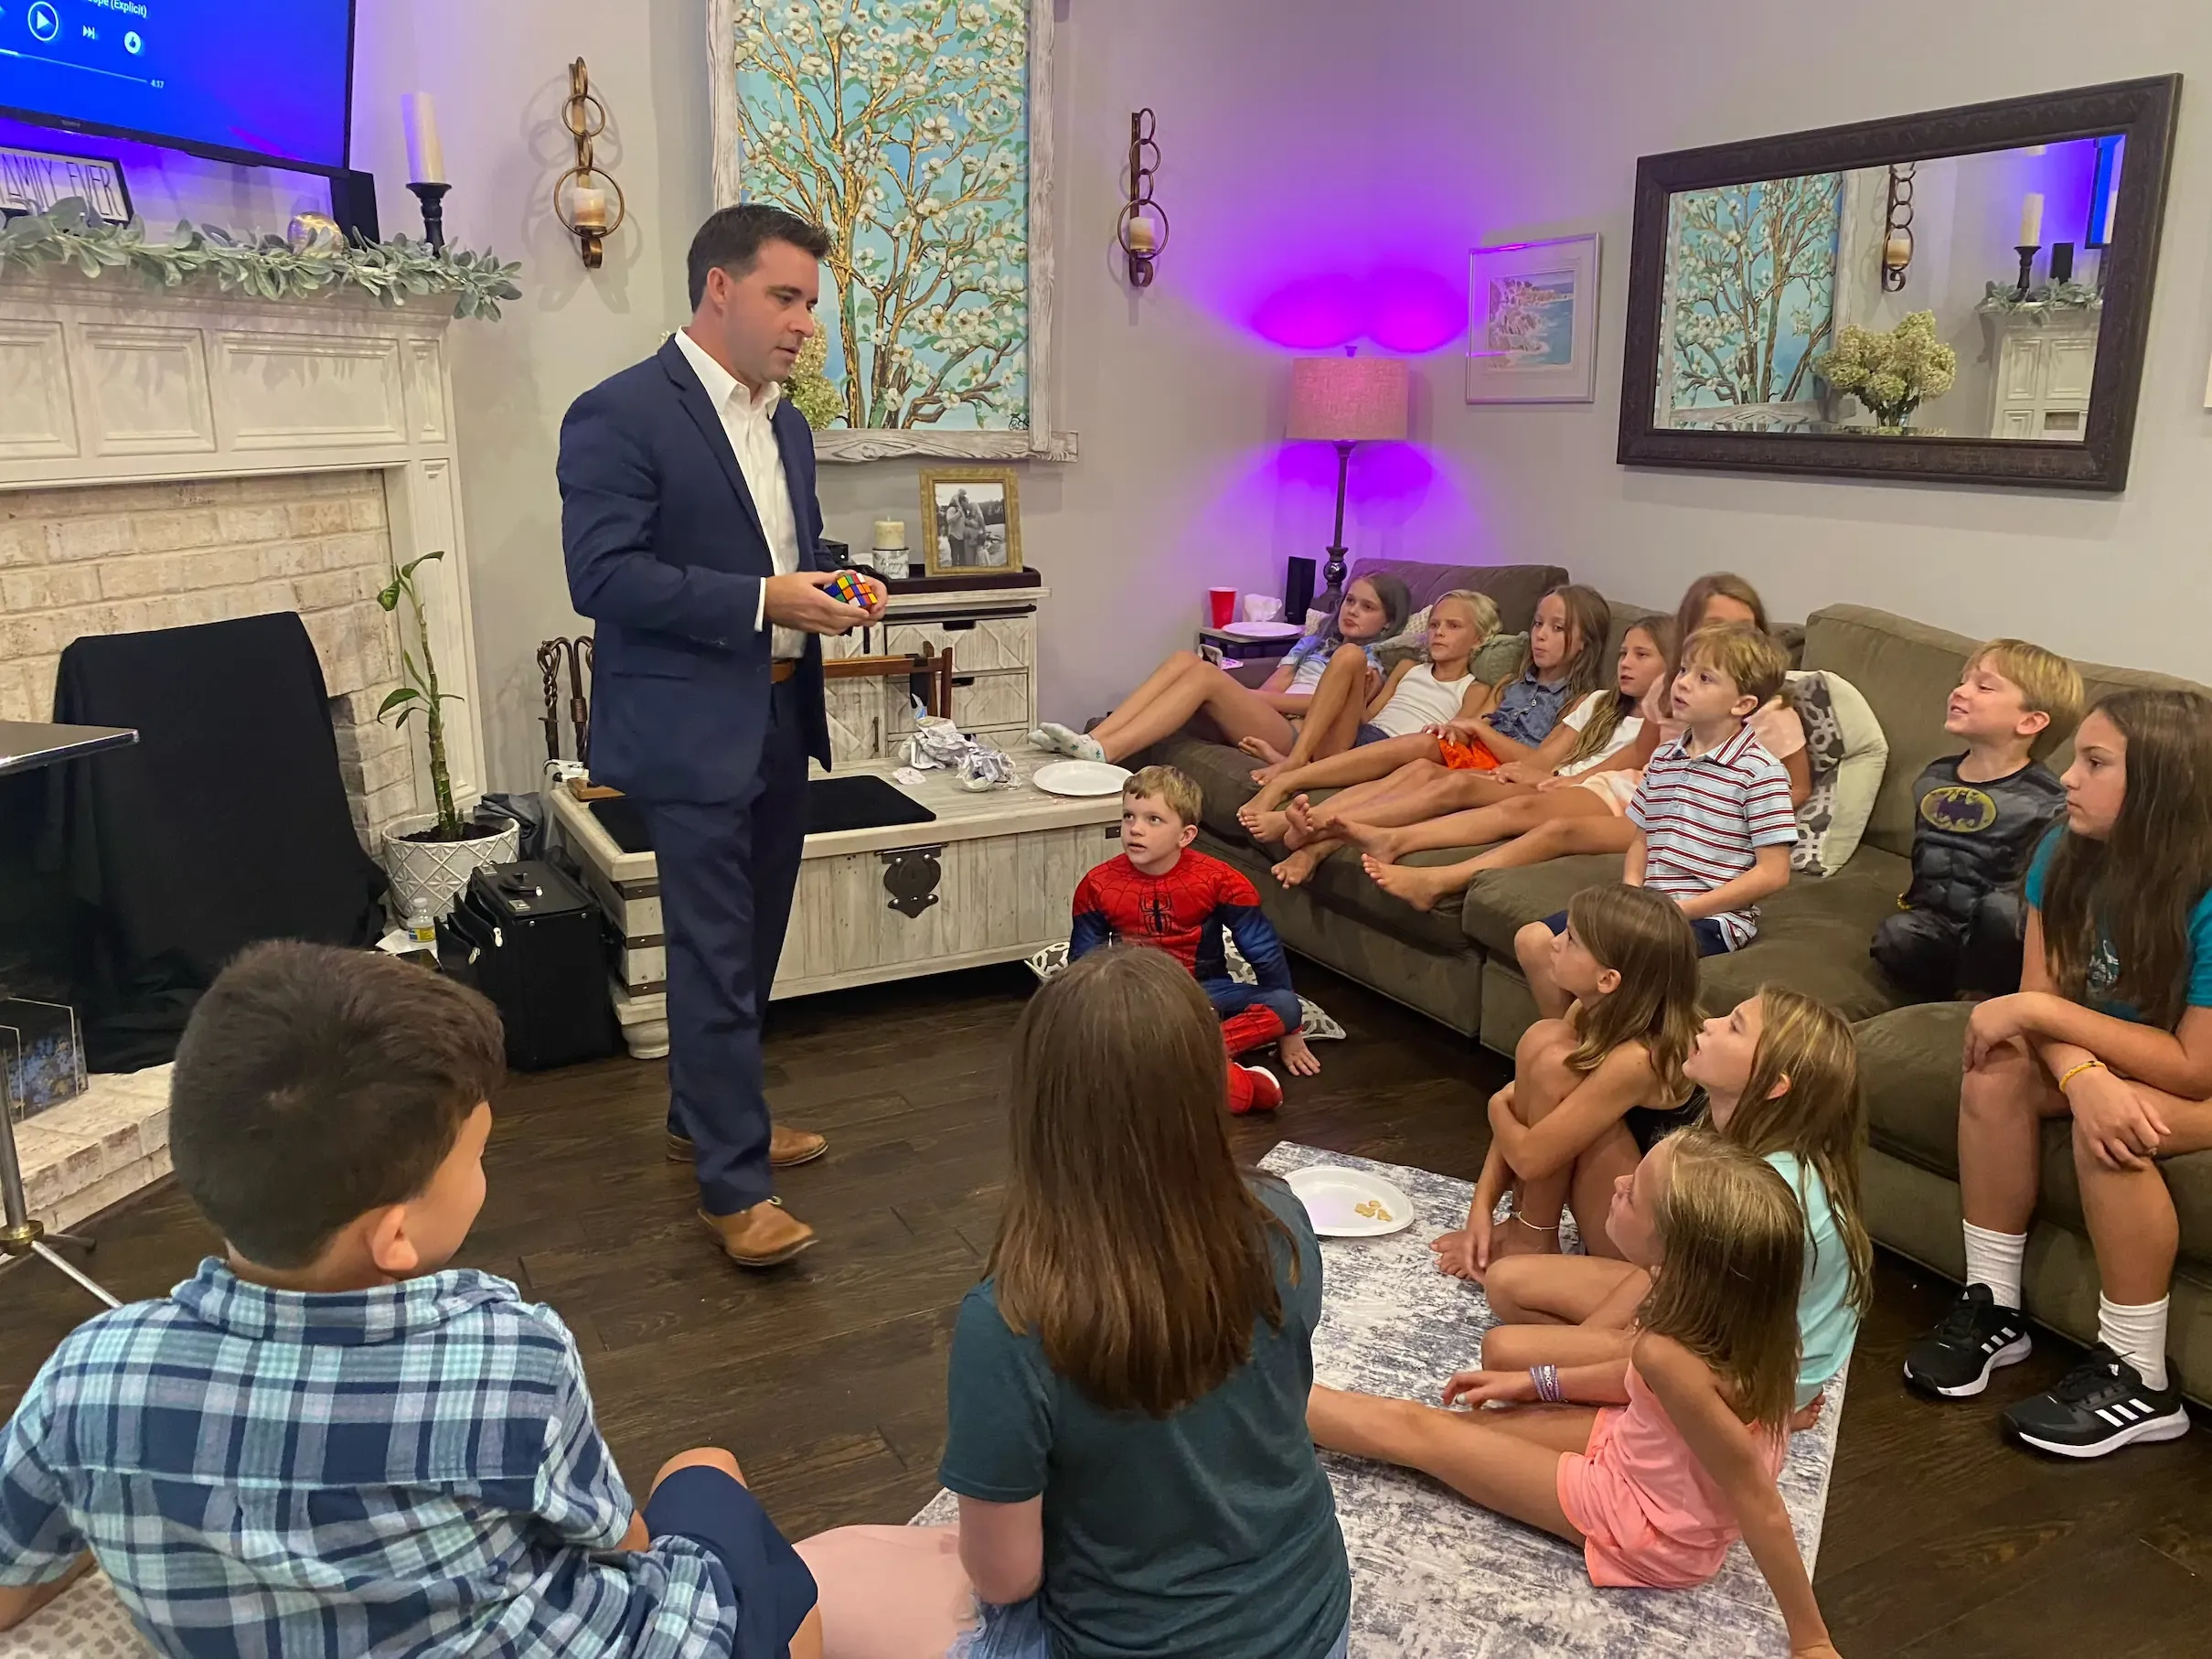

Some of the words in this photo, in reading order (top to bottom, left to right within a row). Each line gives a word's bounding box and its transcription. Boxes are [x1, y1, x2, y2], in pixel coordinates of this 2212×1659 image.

[111, 0, 147, 18] (Explicit)
[0, 154, 58, 209] AMILY
[66, 161, 122, 217] EVER
